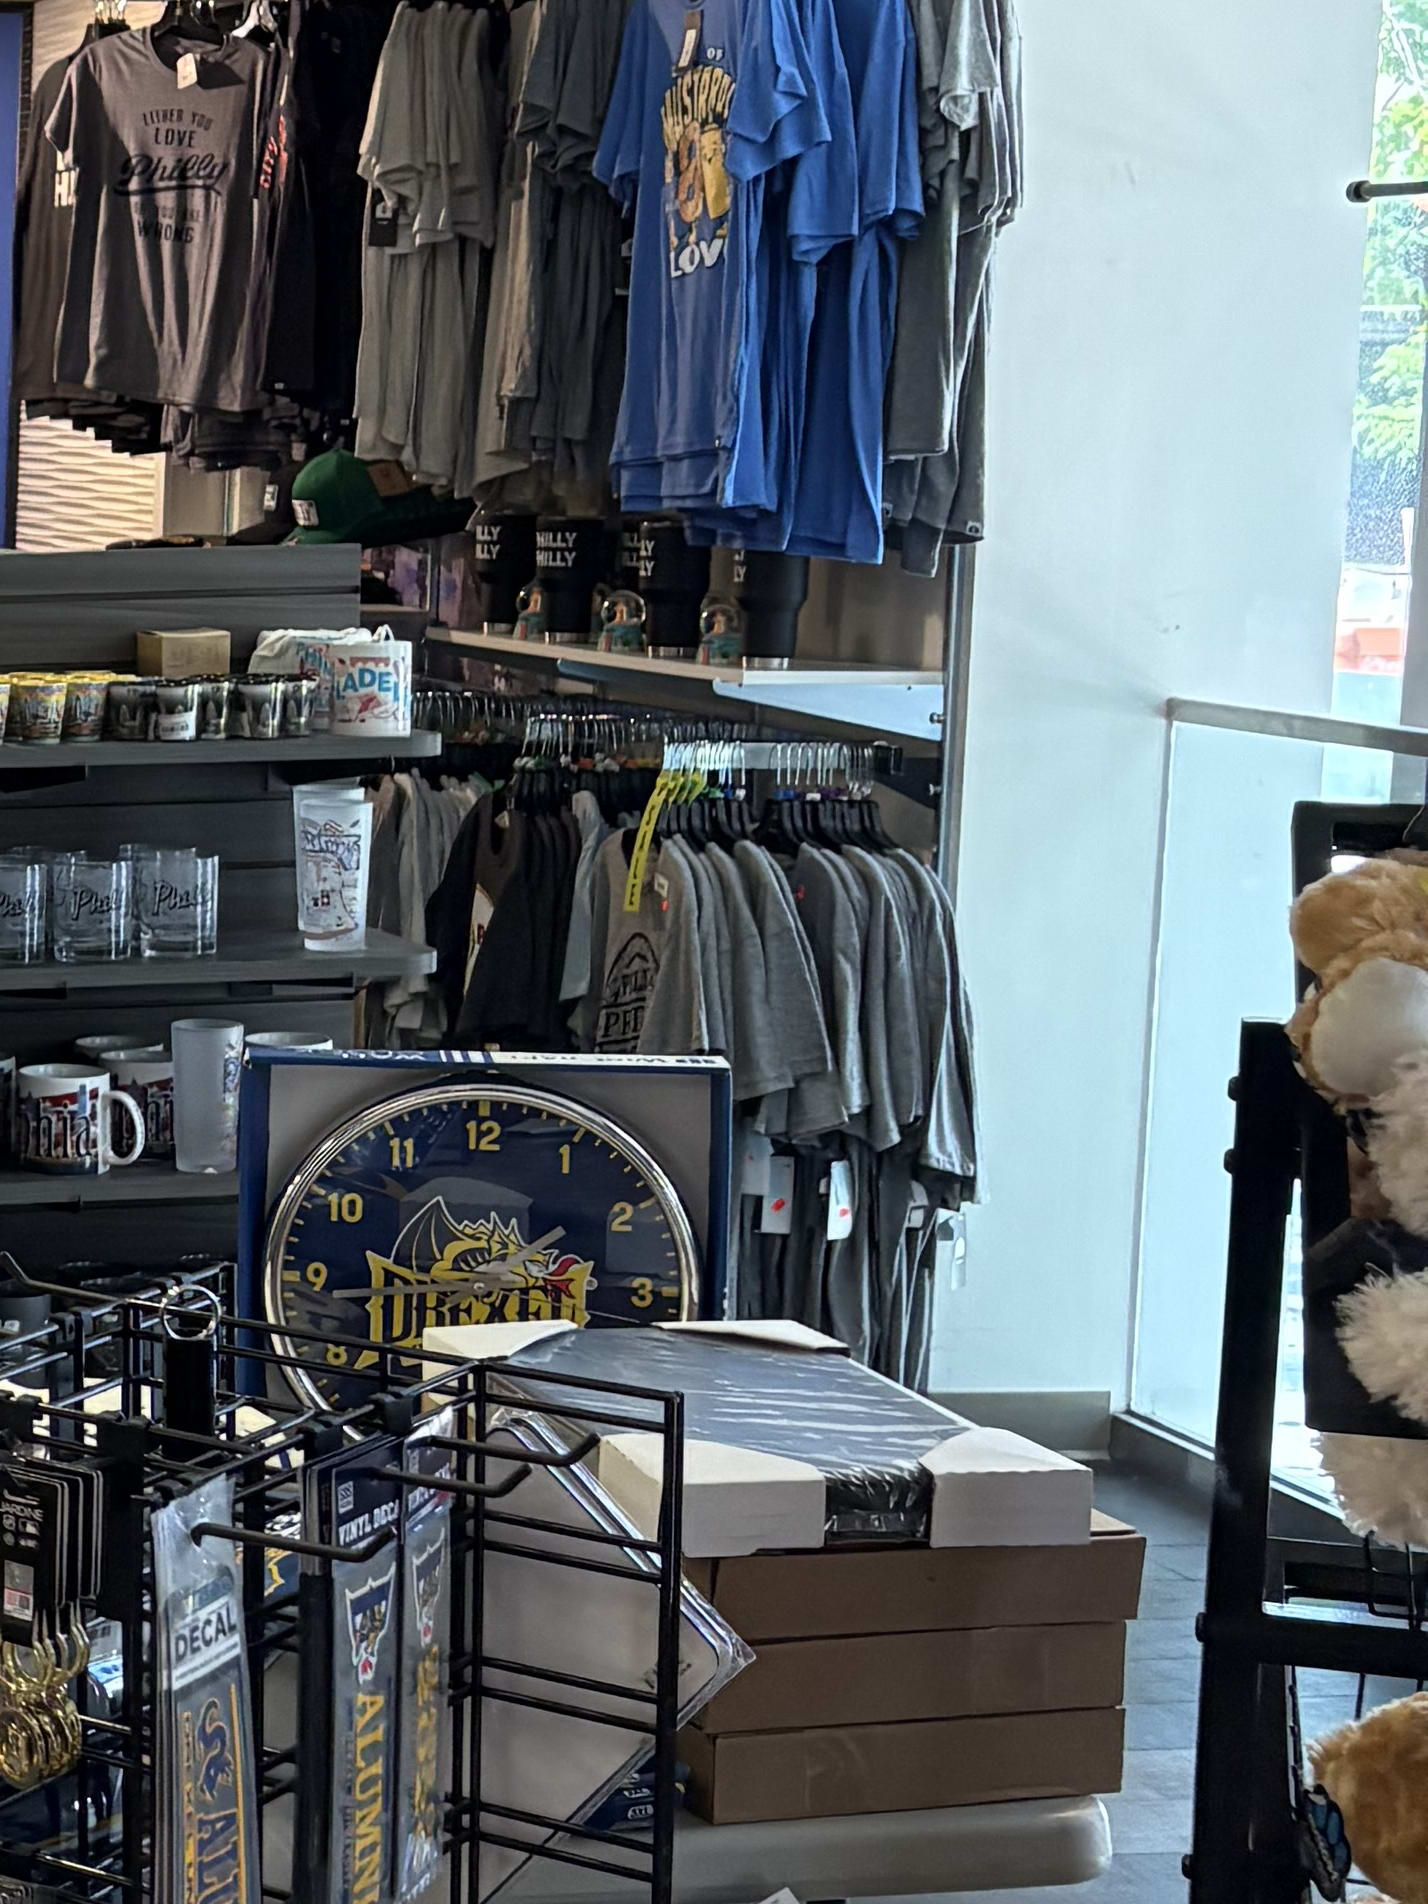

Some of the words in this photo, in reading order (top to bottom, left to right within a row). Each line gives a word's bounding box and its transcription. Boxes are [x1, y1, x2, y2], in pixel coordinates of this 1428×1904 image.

[154, 127, 197, 149] LOVE
[118, 152, 228, 192] Philly
[670, 236, 726, 280] LOV
[465, 1119, 501, 1152] 12
[390, 1138, 415, 1168] 11
[558, 1144, 571, 1174] 1
[327, 1192, 364, 1224] 10
[610, 1202, 633, 1232] 2
[306, 1262, 329, 1292] 9
[630, 1277, 654, 1307] 3
[339, 1514, 372, 1546] VINYL
[174, 1610, 238, 1662] DECAL
